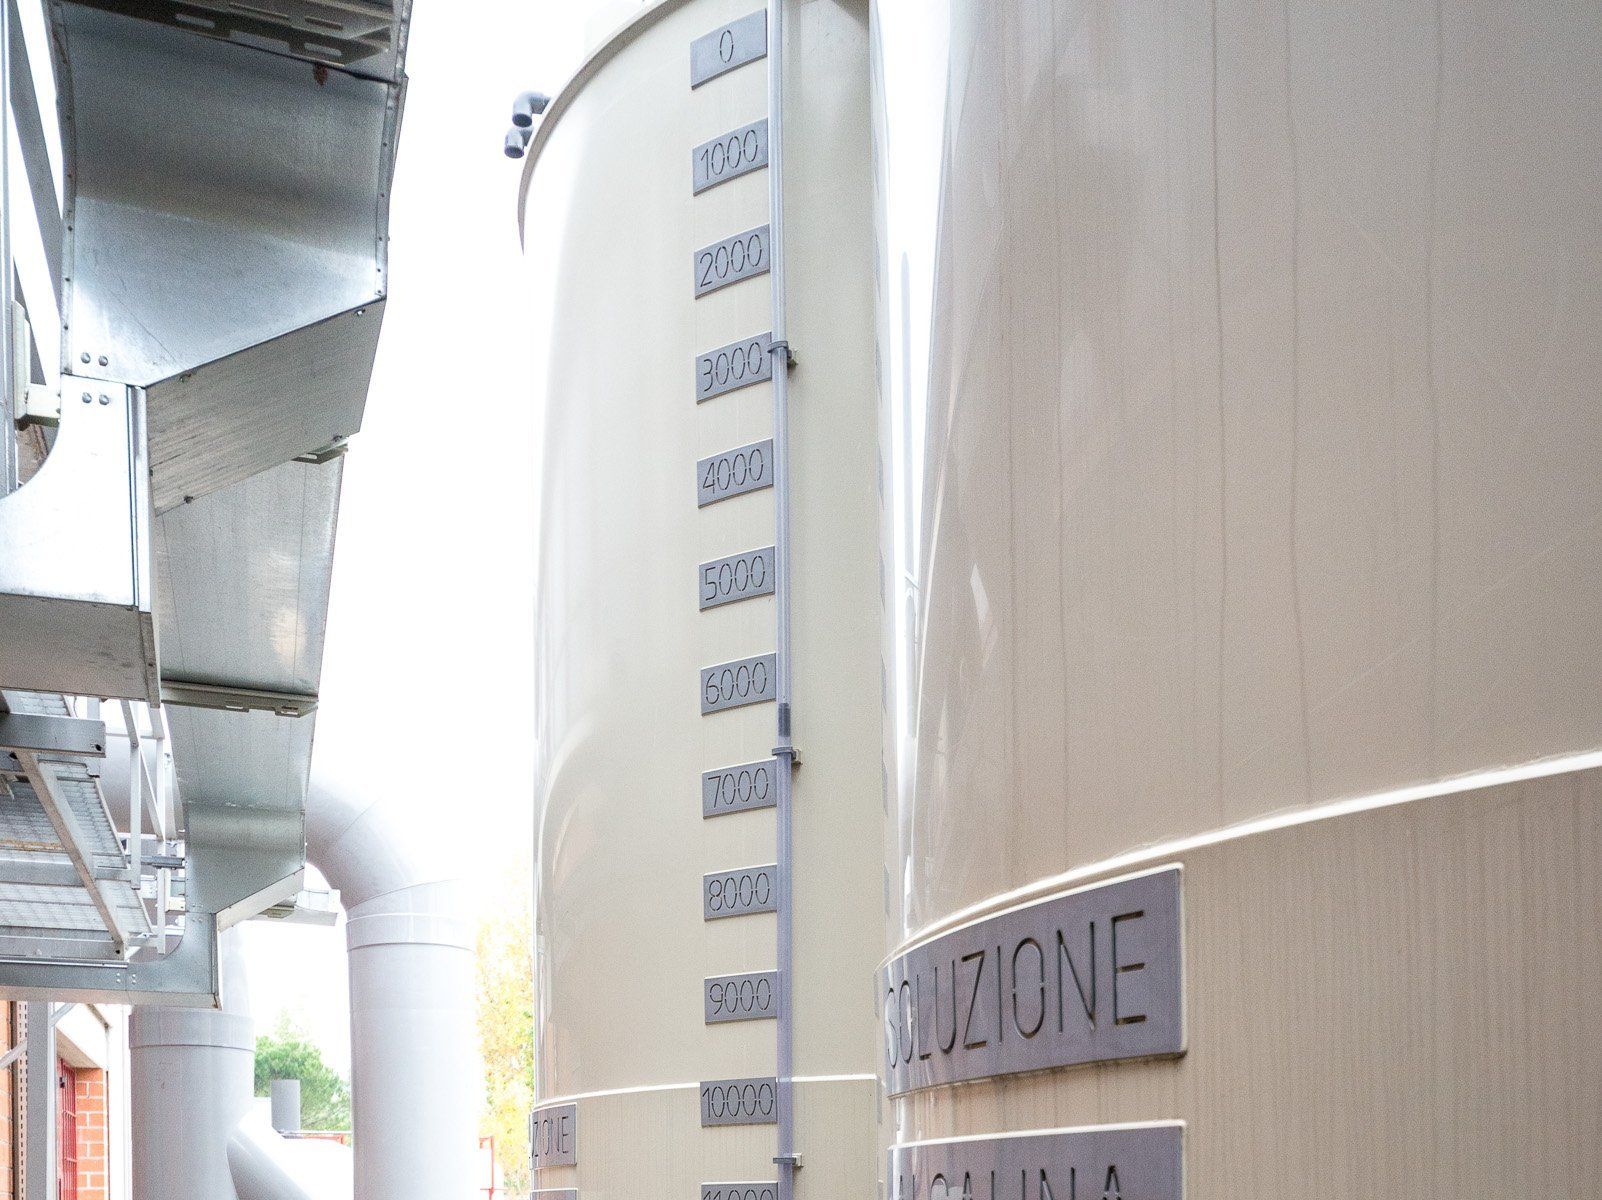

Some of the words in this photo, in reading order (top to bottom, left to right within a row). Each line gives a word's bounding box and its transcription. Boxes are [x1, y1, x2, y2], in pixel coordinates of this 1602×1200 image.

[719, 30, 734, 64] 0
[701, 129, 759, 181] 1000
[700, 234, 763, 288] 2000
[703, 341, 763, 393] 3000
[702, 448, 764, 494] 4000
[705, 555, 766, 601] 5000
[705, 661, 767, 705] 6000
[708, 767, 769, 809] 7000
[709, 872, 770, 912] 8000
[710, 978, 772, 1015] 9000
[884, 910, 1148, 1071] SOLUZIONE
[702, 1082, 774, 1119] 10000
